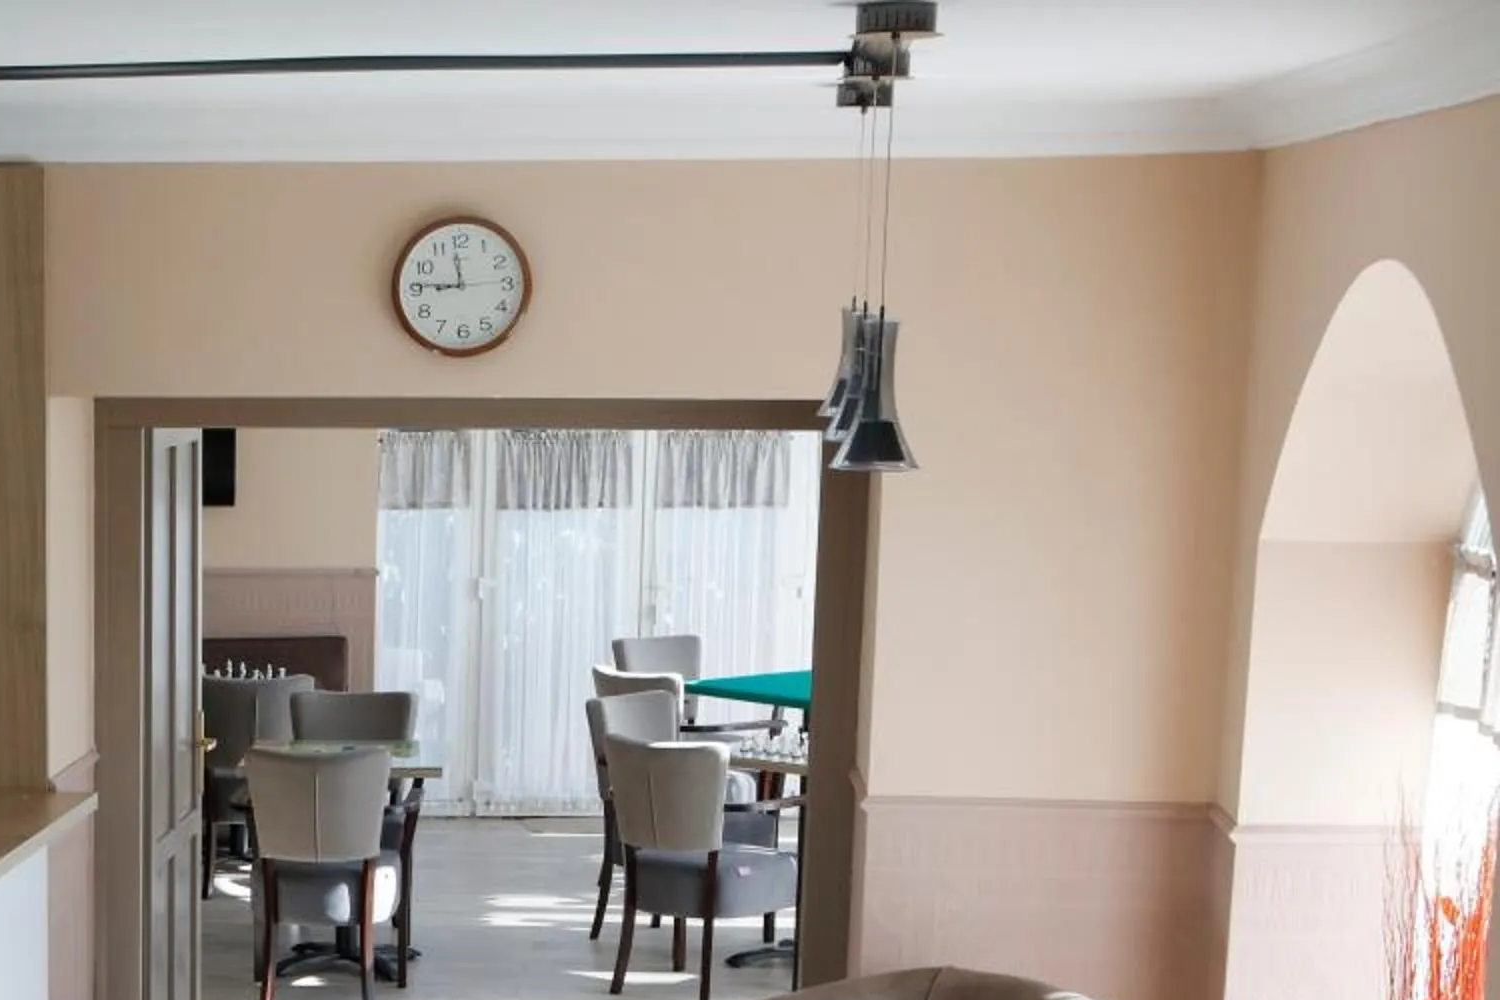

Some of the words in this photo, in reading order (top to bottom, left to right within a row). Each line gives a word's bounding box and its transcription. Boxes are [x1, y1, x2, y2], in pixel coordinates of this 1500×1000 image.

[433, 241, 445, 256] 11
[452, 233, 469, 249] 12
[417, 260, 434, 275] 10
[493, 254, 507, 270] 2
[409, 282, 423, 296] 9
[501, 276, 514, 291] 3
[418, 303, 431, 318] 8
[494, 299, 507, 312] 4
[436, 319, 447, 334] 7
[457, 324, 470, 338] 6
[479, 316, 493, 331] 5
